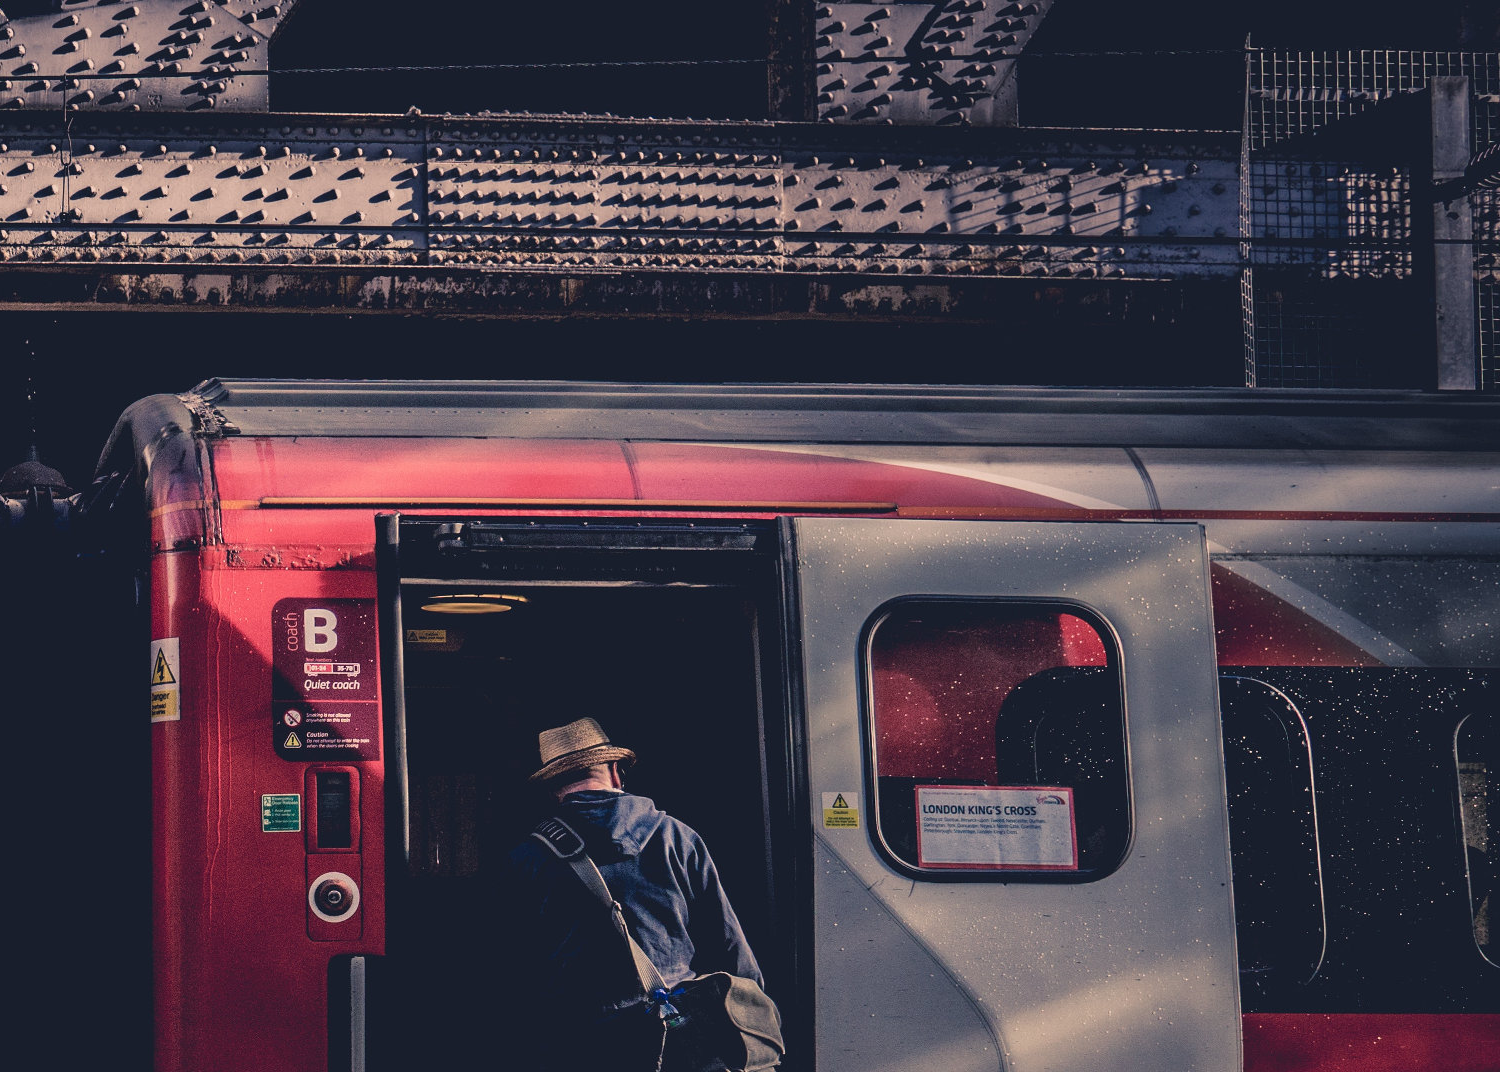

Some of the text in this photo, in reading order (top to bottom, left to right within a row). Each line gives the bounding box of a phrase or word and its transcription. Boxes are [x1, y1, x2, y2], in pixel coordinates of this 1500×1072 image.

[284, 612, 298, 651] coach
[304, 608, 338, 652] B
[304, 679, 360, 691] Quiet coach
[923, 804, 1037, 816] LONDON KING'S CROSS
